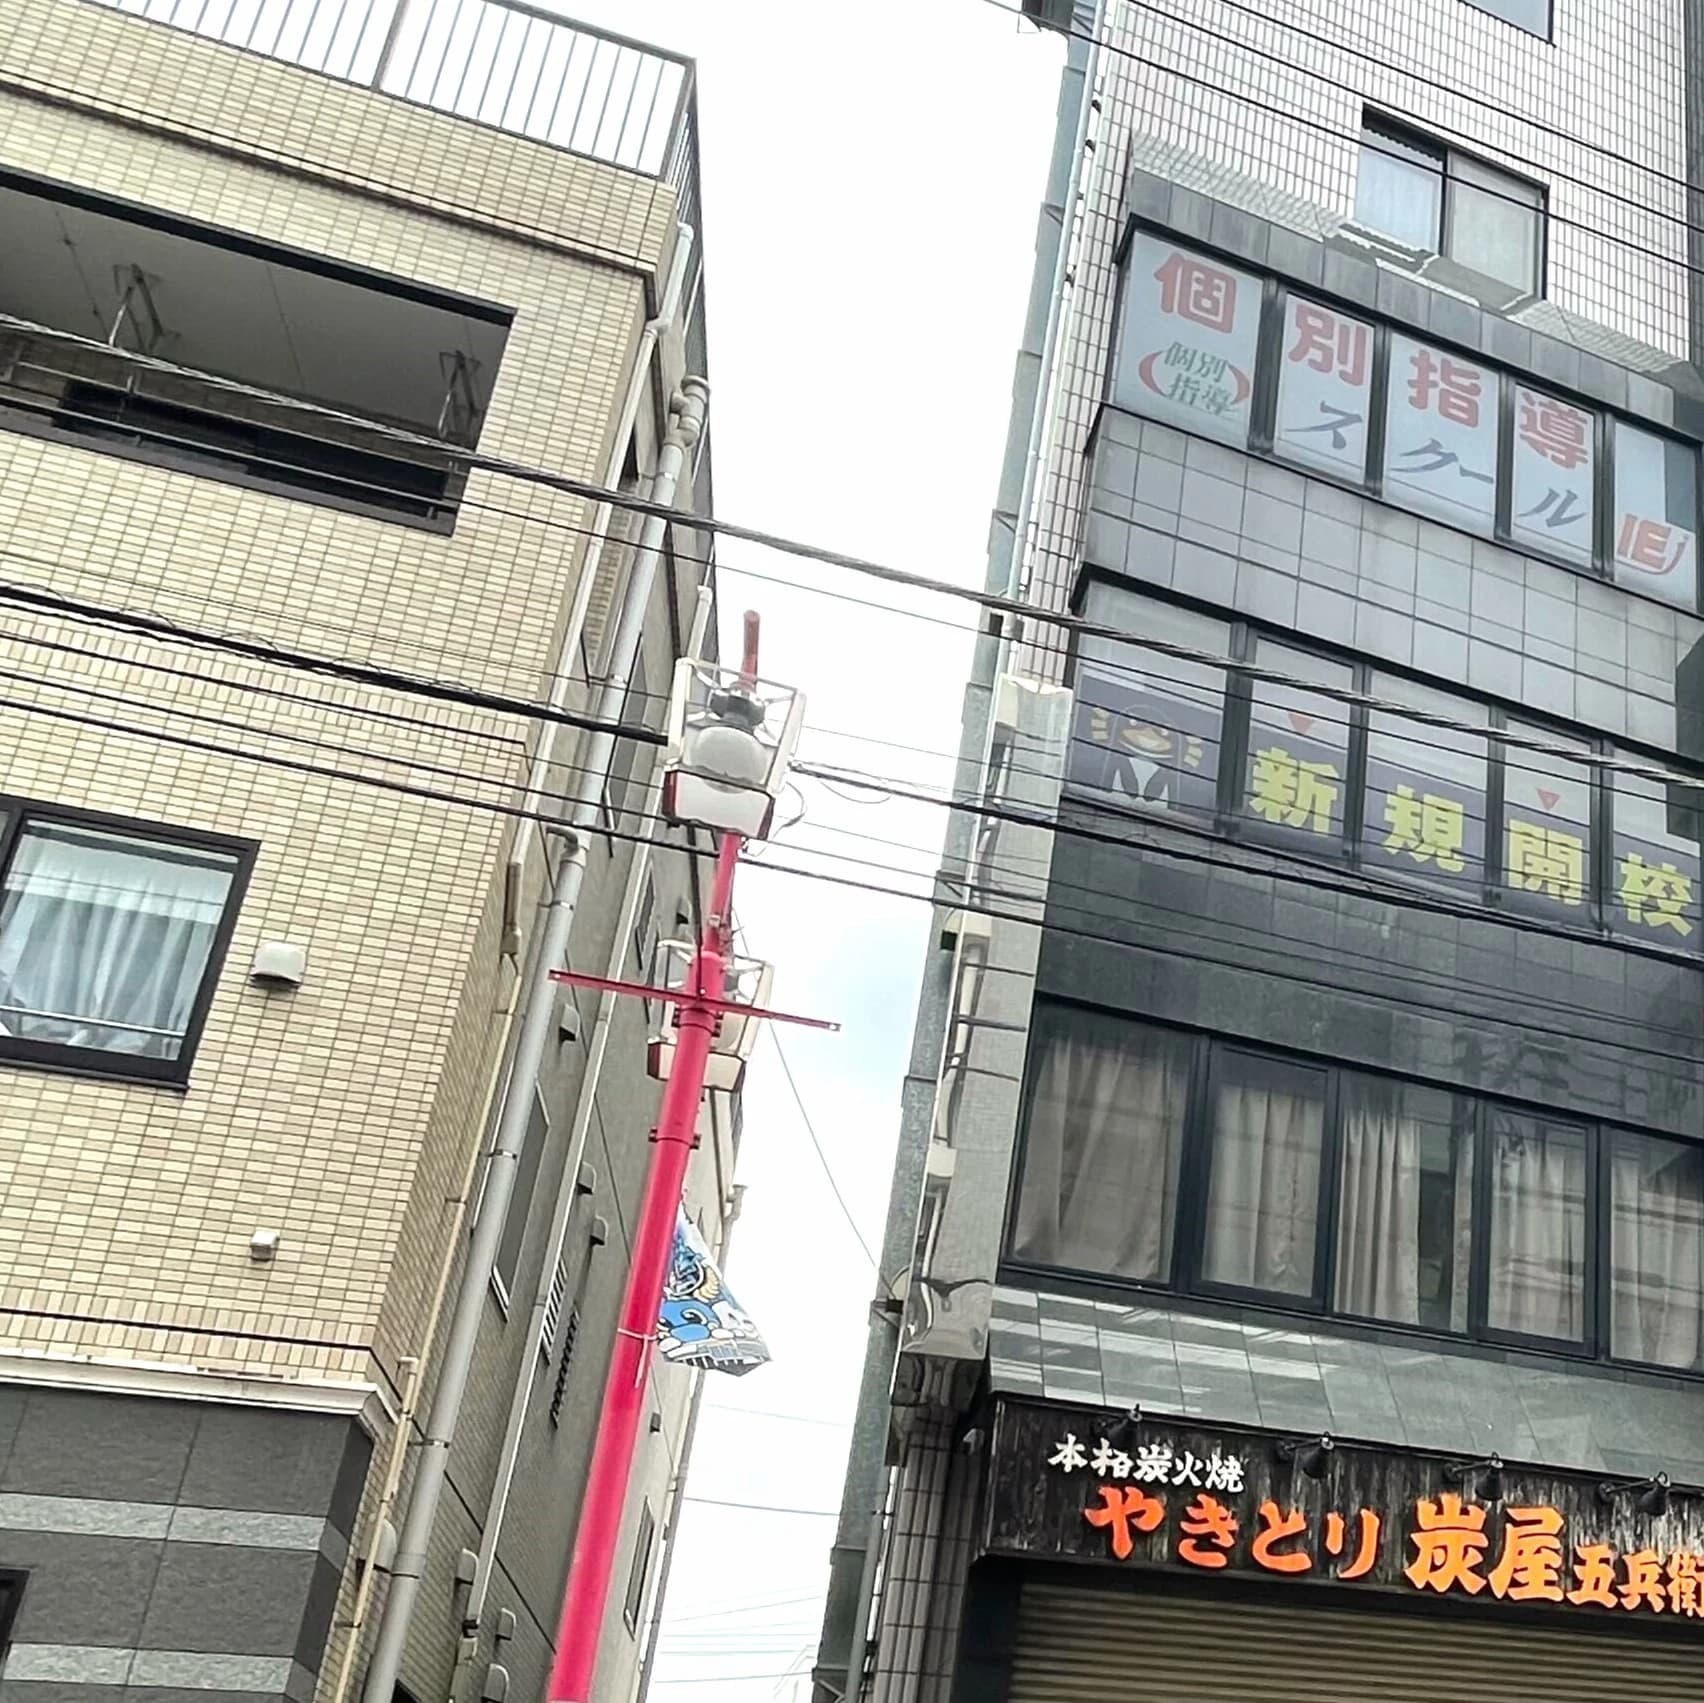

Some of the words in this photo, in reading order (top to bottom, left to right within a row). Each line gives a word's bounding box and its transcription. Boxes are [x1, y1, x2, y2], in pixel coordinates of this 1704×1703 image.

[1153, 252, 1589, 471] 個別指導
[1248, 745, 1694, 937] 新規開校
[1084, 1486, 1382, 1580] やきとり
